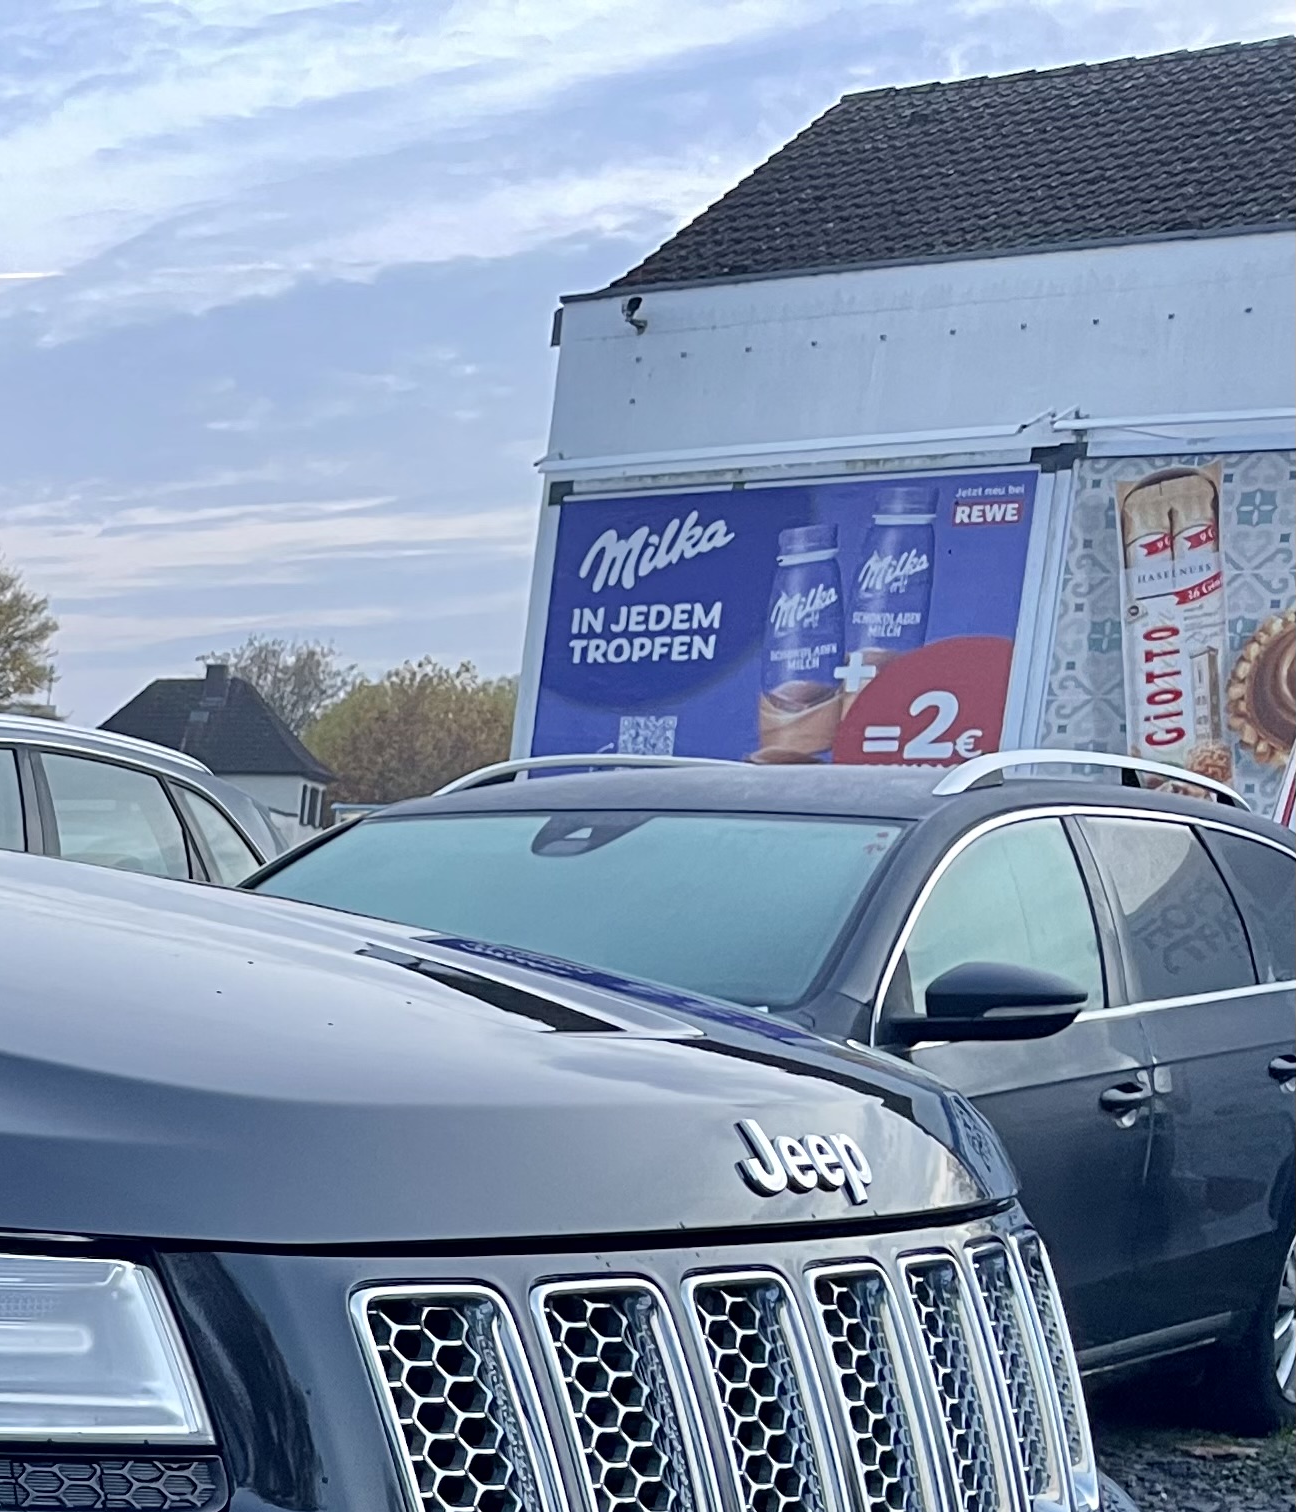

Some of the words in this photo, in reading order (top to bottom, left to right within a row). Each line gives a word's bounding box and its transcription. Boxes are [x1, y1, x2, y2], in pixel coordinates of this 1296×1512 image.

[984, 486, 1006, 496] neu
[1008, 484, 1025, 495] bei
[955, 503, 1019, 524] REWE
[579, 510, 735, 593] Milka
[858, 548, 929, 591] Milka
[1137, 563, 1212, 584] HASELNUSS
[571, 606, 605, 634] IN
[610, 601, 723, 632] JEDEM
[770, 583, 838, 634] Milka
[569, 634, 717, 664] TROPFEN
[733, 1118, 873, 1206] Jeep
